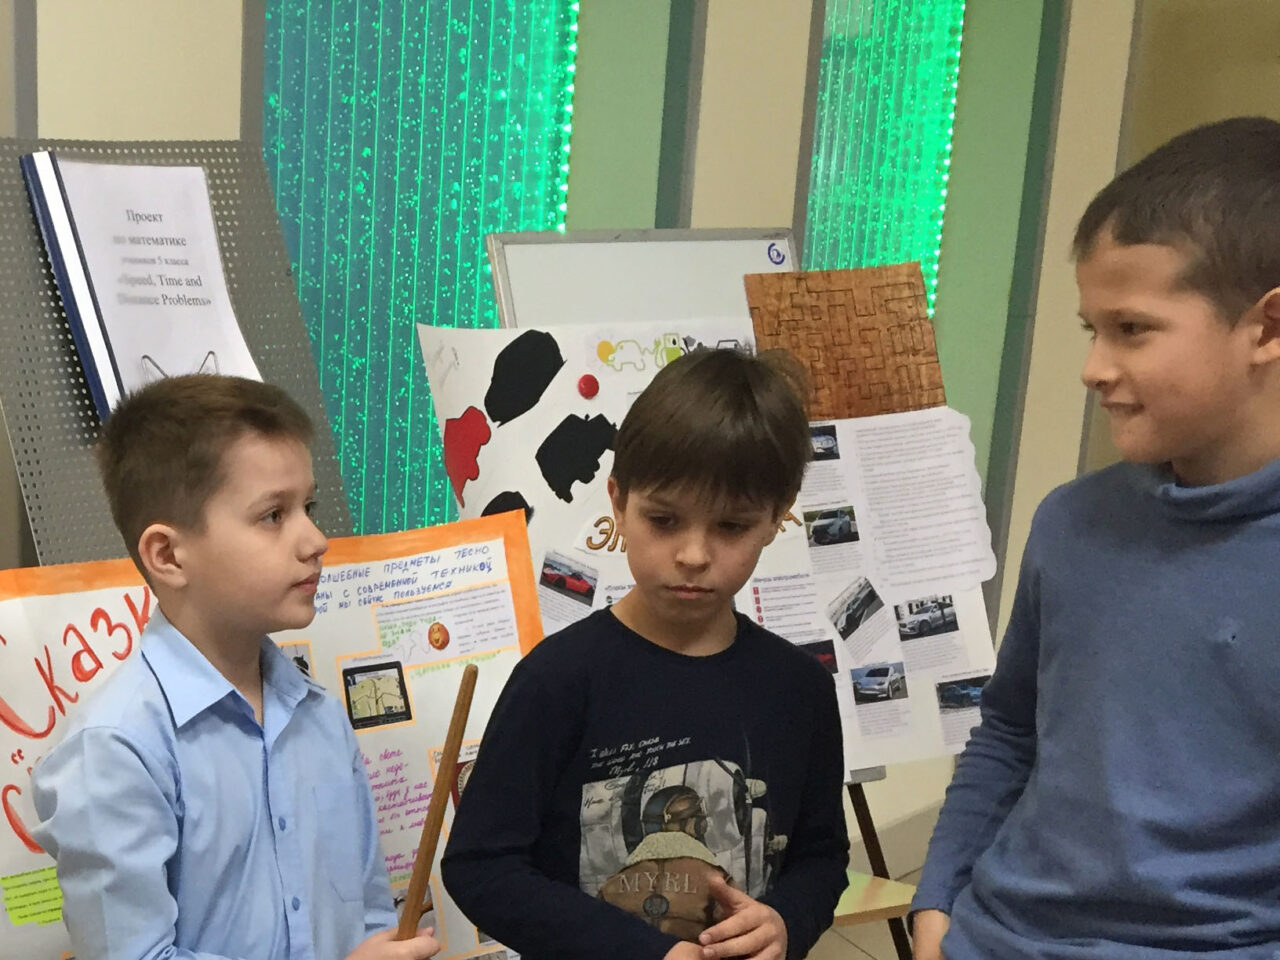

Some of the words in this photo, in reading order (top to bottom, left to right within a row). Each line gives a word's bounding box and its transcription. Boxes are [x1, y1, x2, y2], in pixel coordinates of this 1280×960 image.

[126, 210, 163, 224] Проект
[128, 236, 186, 246] математике
[157, 274, 183, 286] Time
[186, 276, 202, 287] and
[319, 567, 370, 583] ОЛШЕБНЫЕ
[455, 545, 489, 559] ТЕСНО
[618, 870, 698, 895] MYRL
